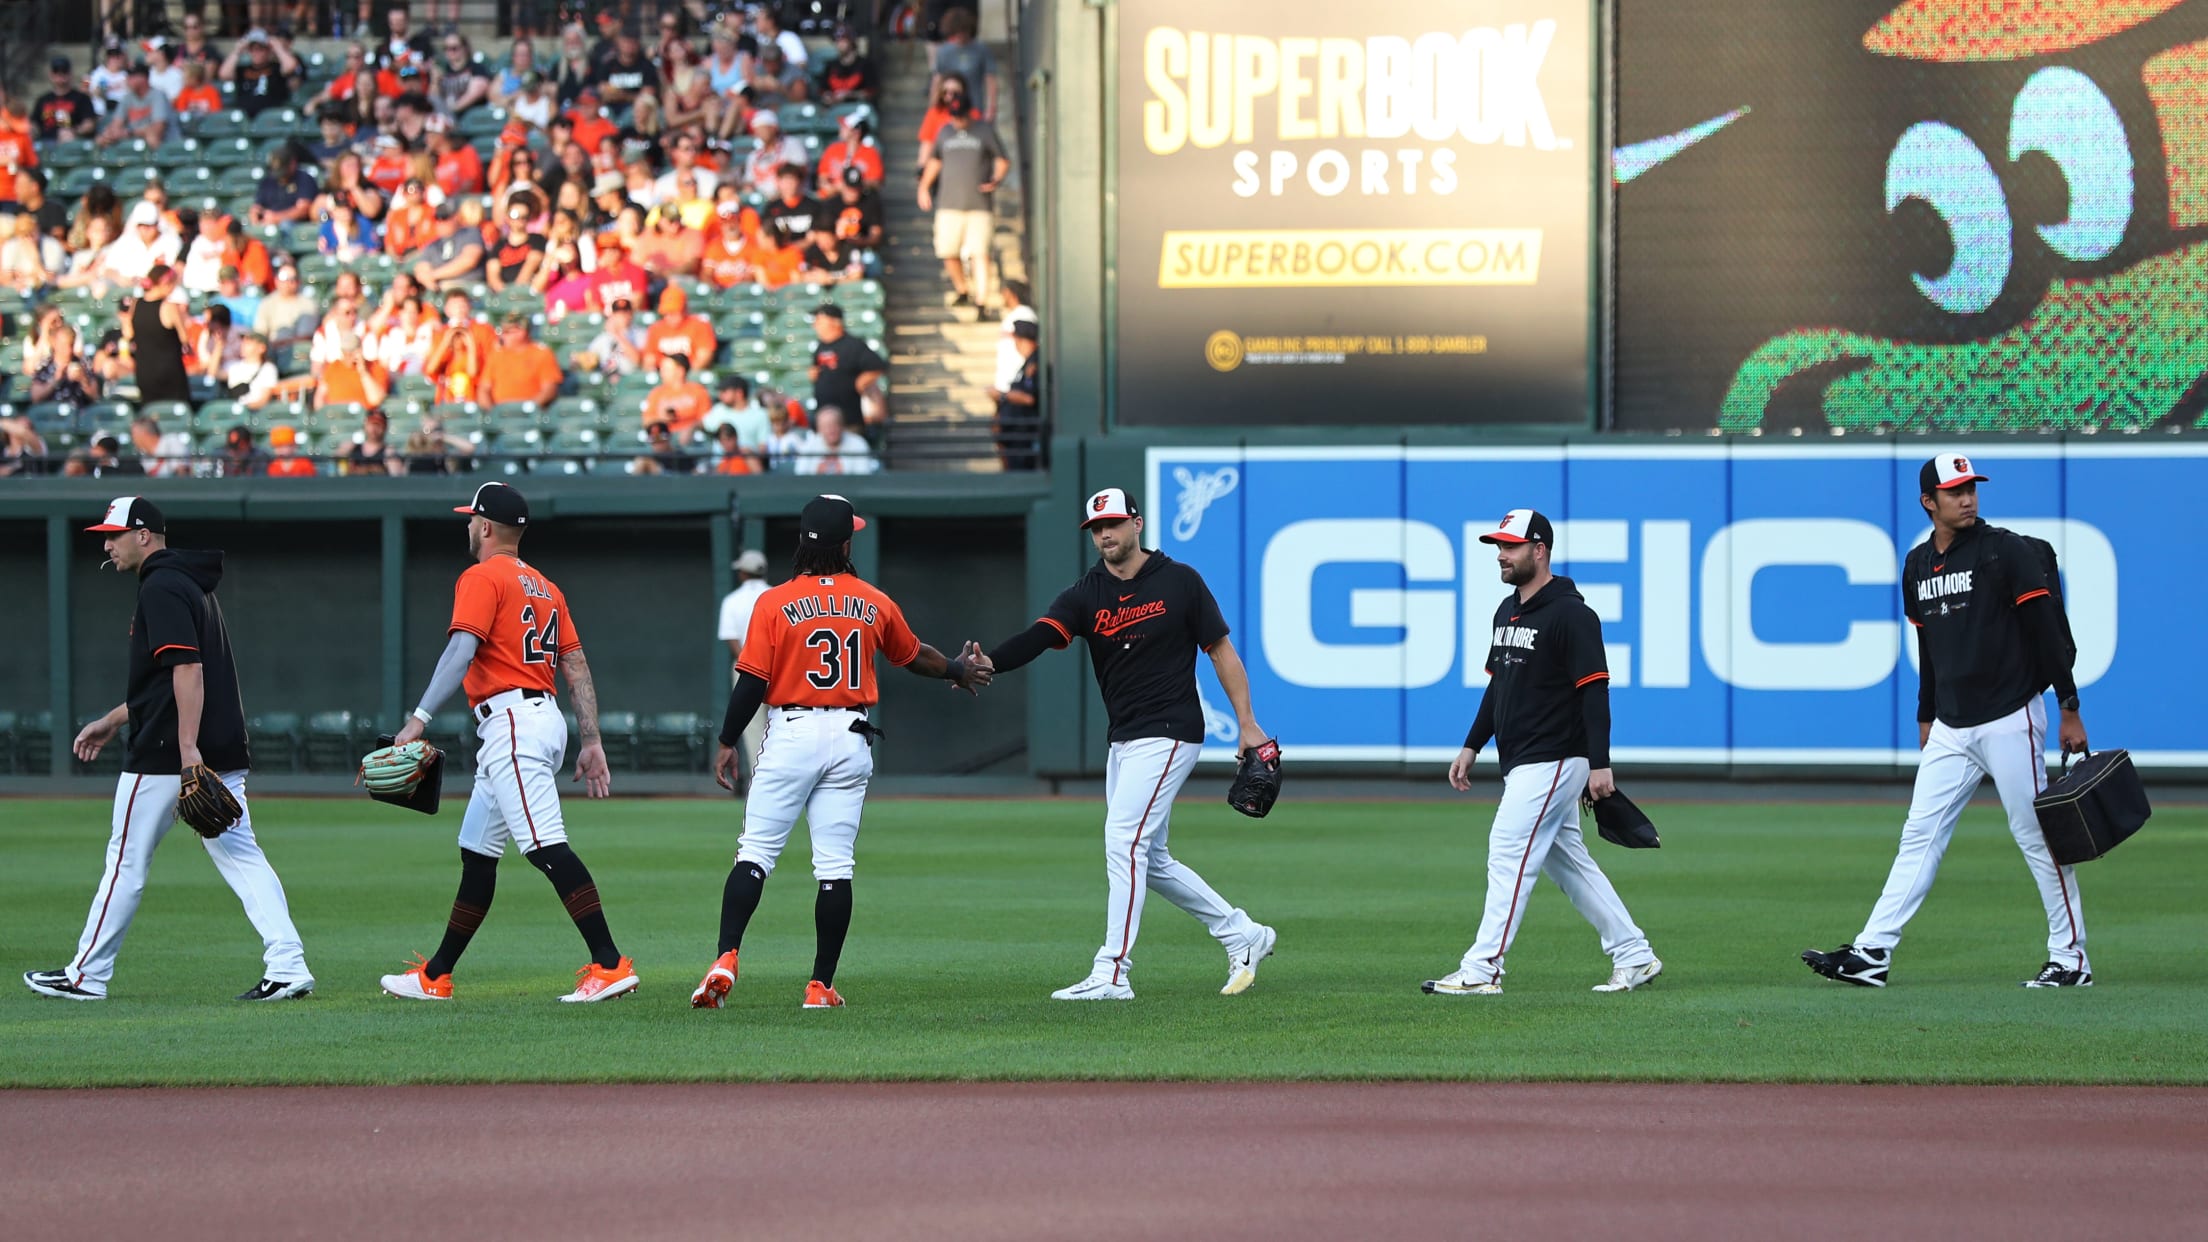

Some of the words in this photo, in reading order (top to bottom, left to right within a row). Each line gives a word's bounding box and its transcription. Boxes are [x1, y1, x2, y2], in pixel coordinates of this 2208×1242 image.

[1143, 18, 1559, 156] SUPERBOOK
[1231, 148, 1459, 198] SPORTS
[1174, 240, 1527, 278] SUPERBOOK.COM
[517, 574, 553, 601] HALL
[1916, 569, 1974, 602] ALTIMORE
[781, 595, 878, 627] MULLINS
[1093, 599, 1167, 637] Baltimore
[520, 603, 559, 668] 24
[1493, 625, 1539, 651] ALTIMORE
[806, 628, 862, 690] 31
